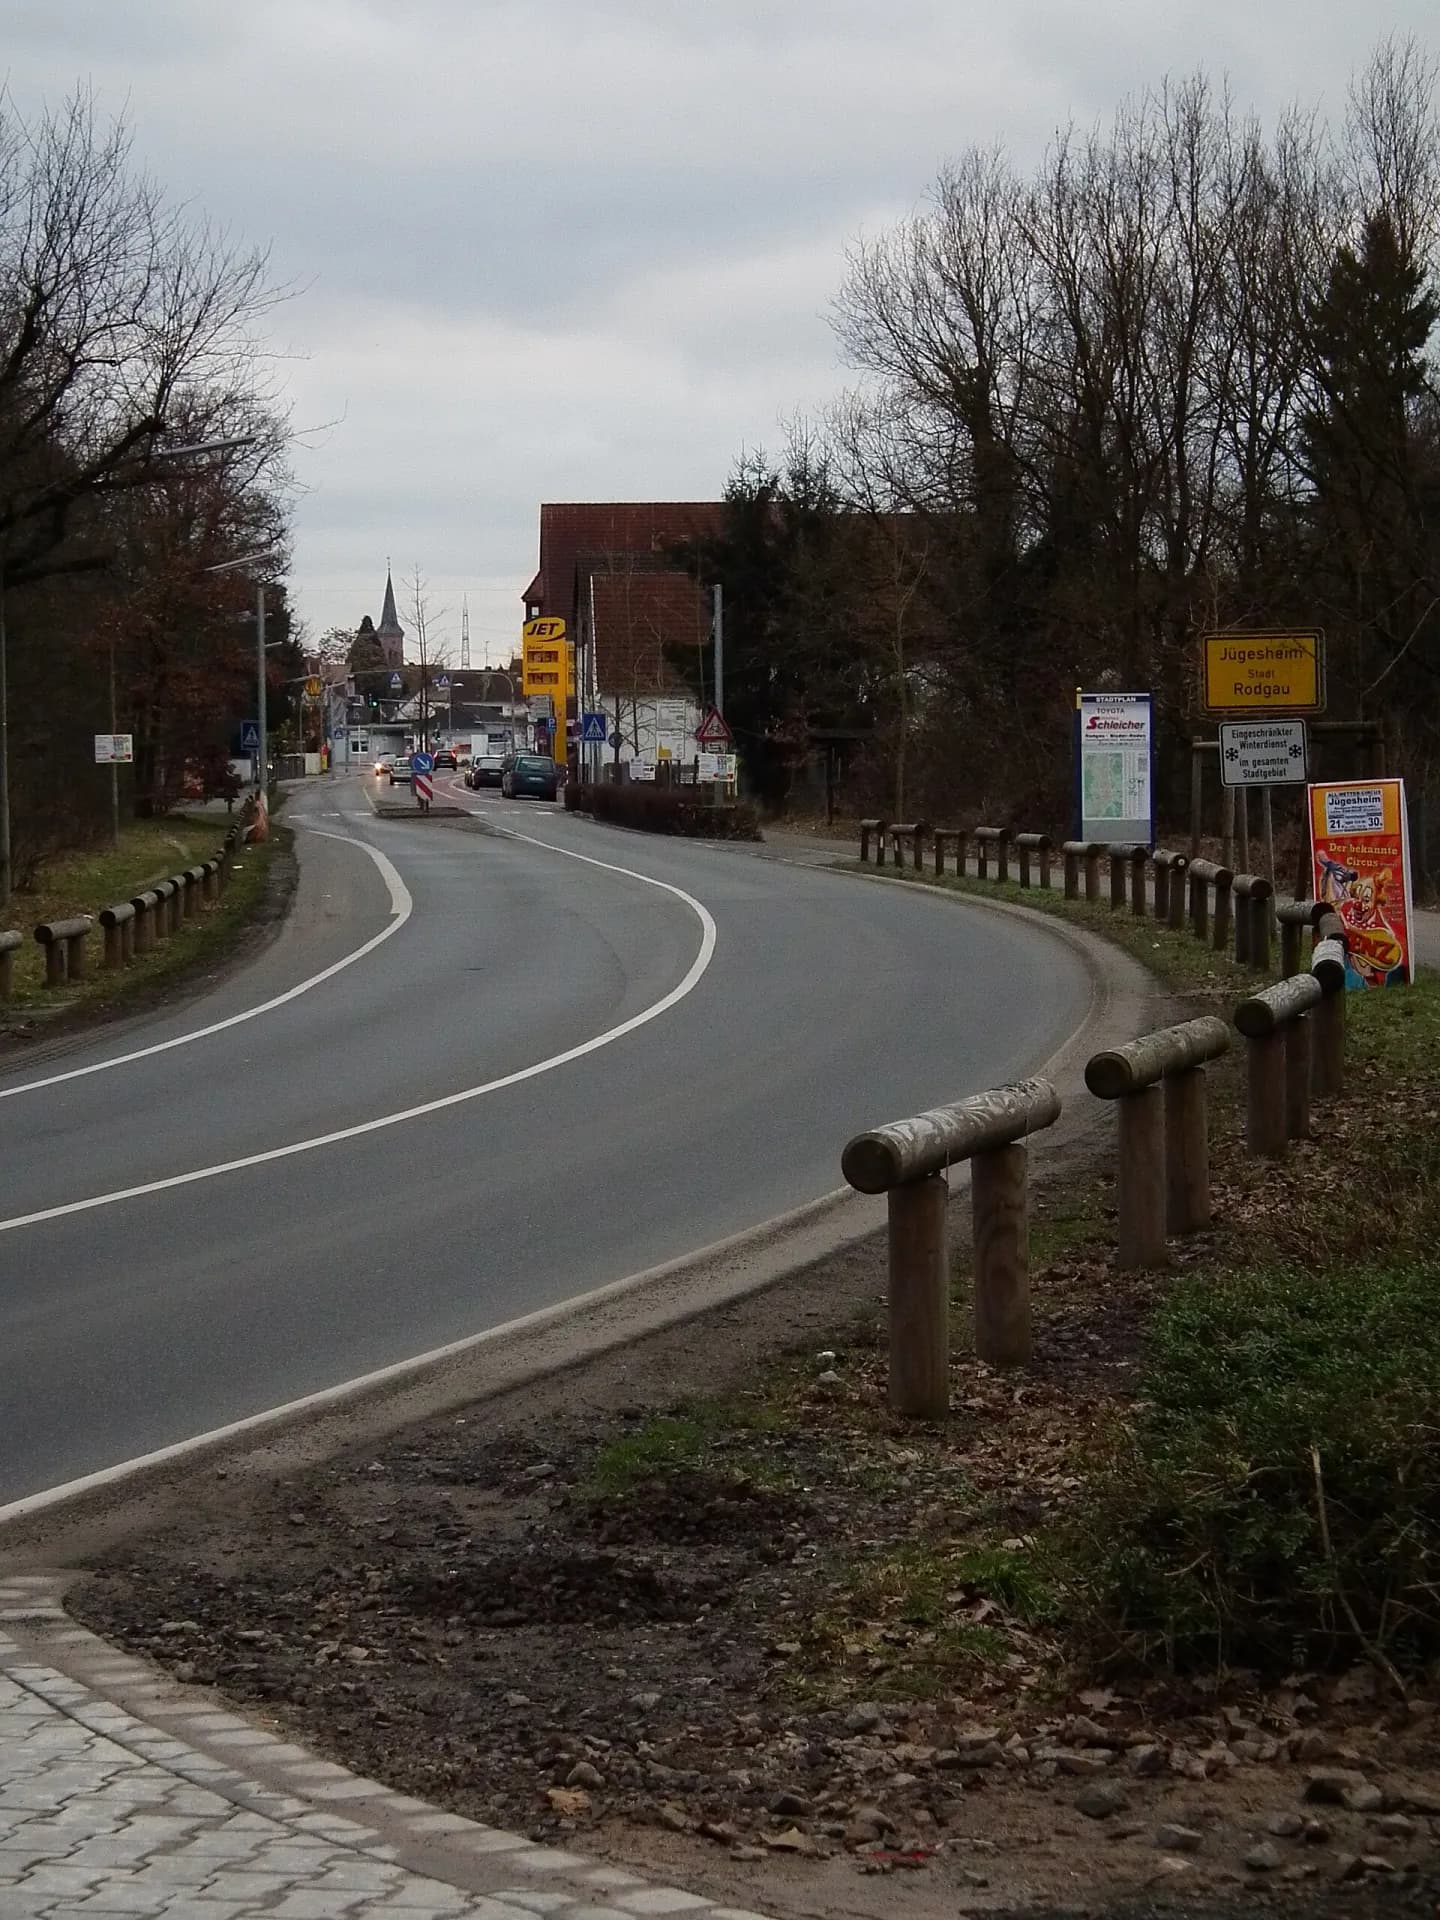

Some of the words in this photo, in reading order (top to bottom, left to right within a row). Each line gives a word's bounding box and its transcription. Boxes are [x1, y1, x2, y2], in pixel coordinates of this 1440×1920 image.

[527, 623, 560, 636] JET
[1219, 645, 1304, 664] Jügesheim
[1247, 669, 1275, 679] Stadt
[1233, 682, 1291, 698] Rodgau
[1086, 716, 1145, 730] Schleicher
[1231, 728, 1294, 740] Eingeschränkter
[1239, 740, 1288, 750] Winterdienst
[1239, 758, 1249, 767] im
[1252, 757, 1289, 768] gesamten
[1242, 768, 1287, 779] Stadtgebiet
[1328, 796, 1381, 806] Jügesheim
[1329, 819, 1345, 829] 21.
[1368, 816, 1383, 827] 30.
[1329, 842, 1347, 852] Der
[1350, 843, 1398, 855] bekannte
[1346, 856, 1379, 868] Circus
